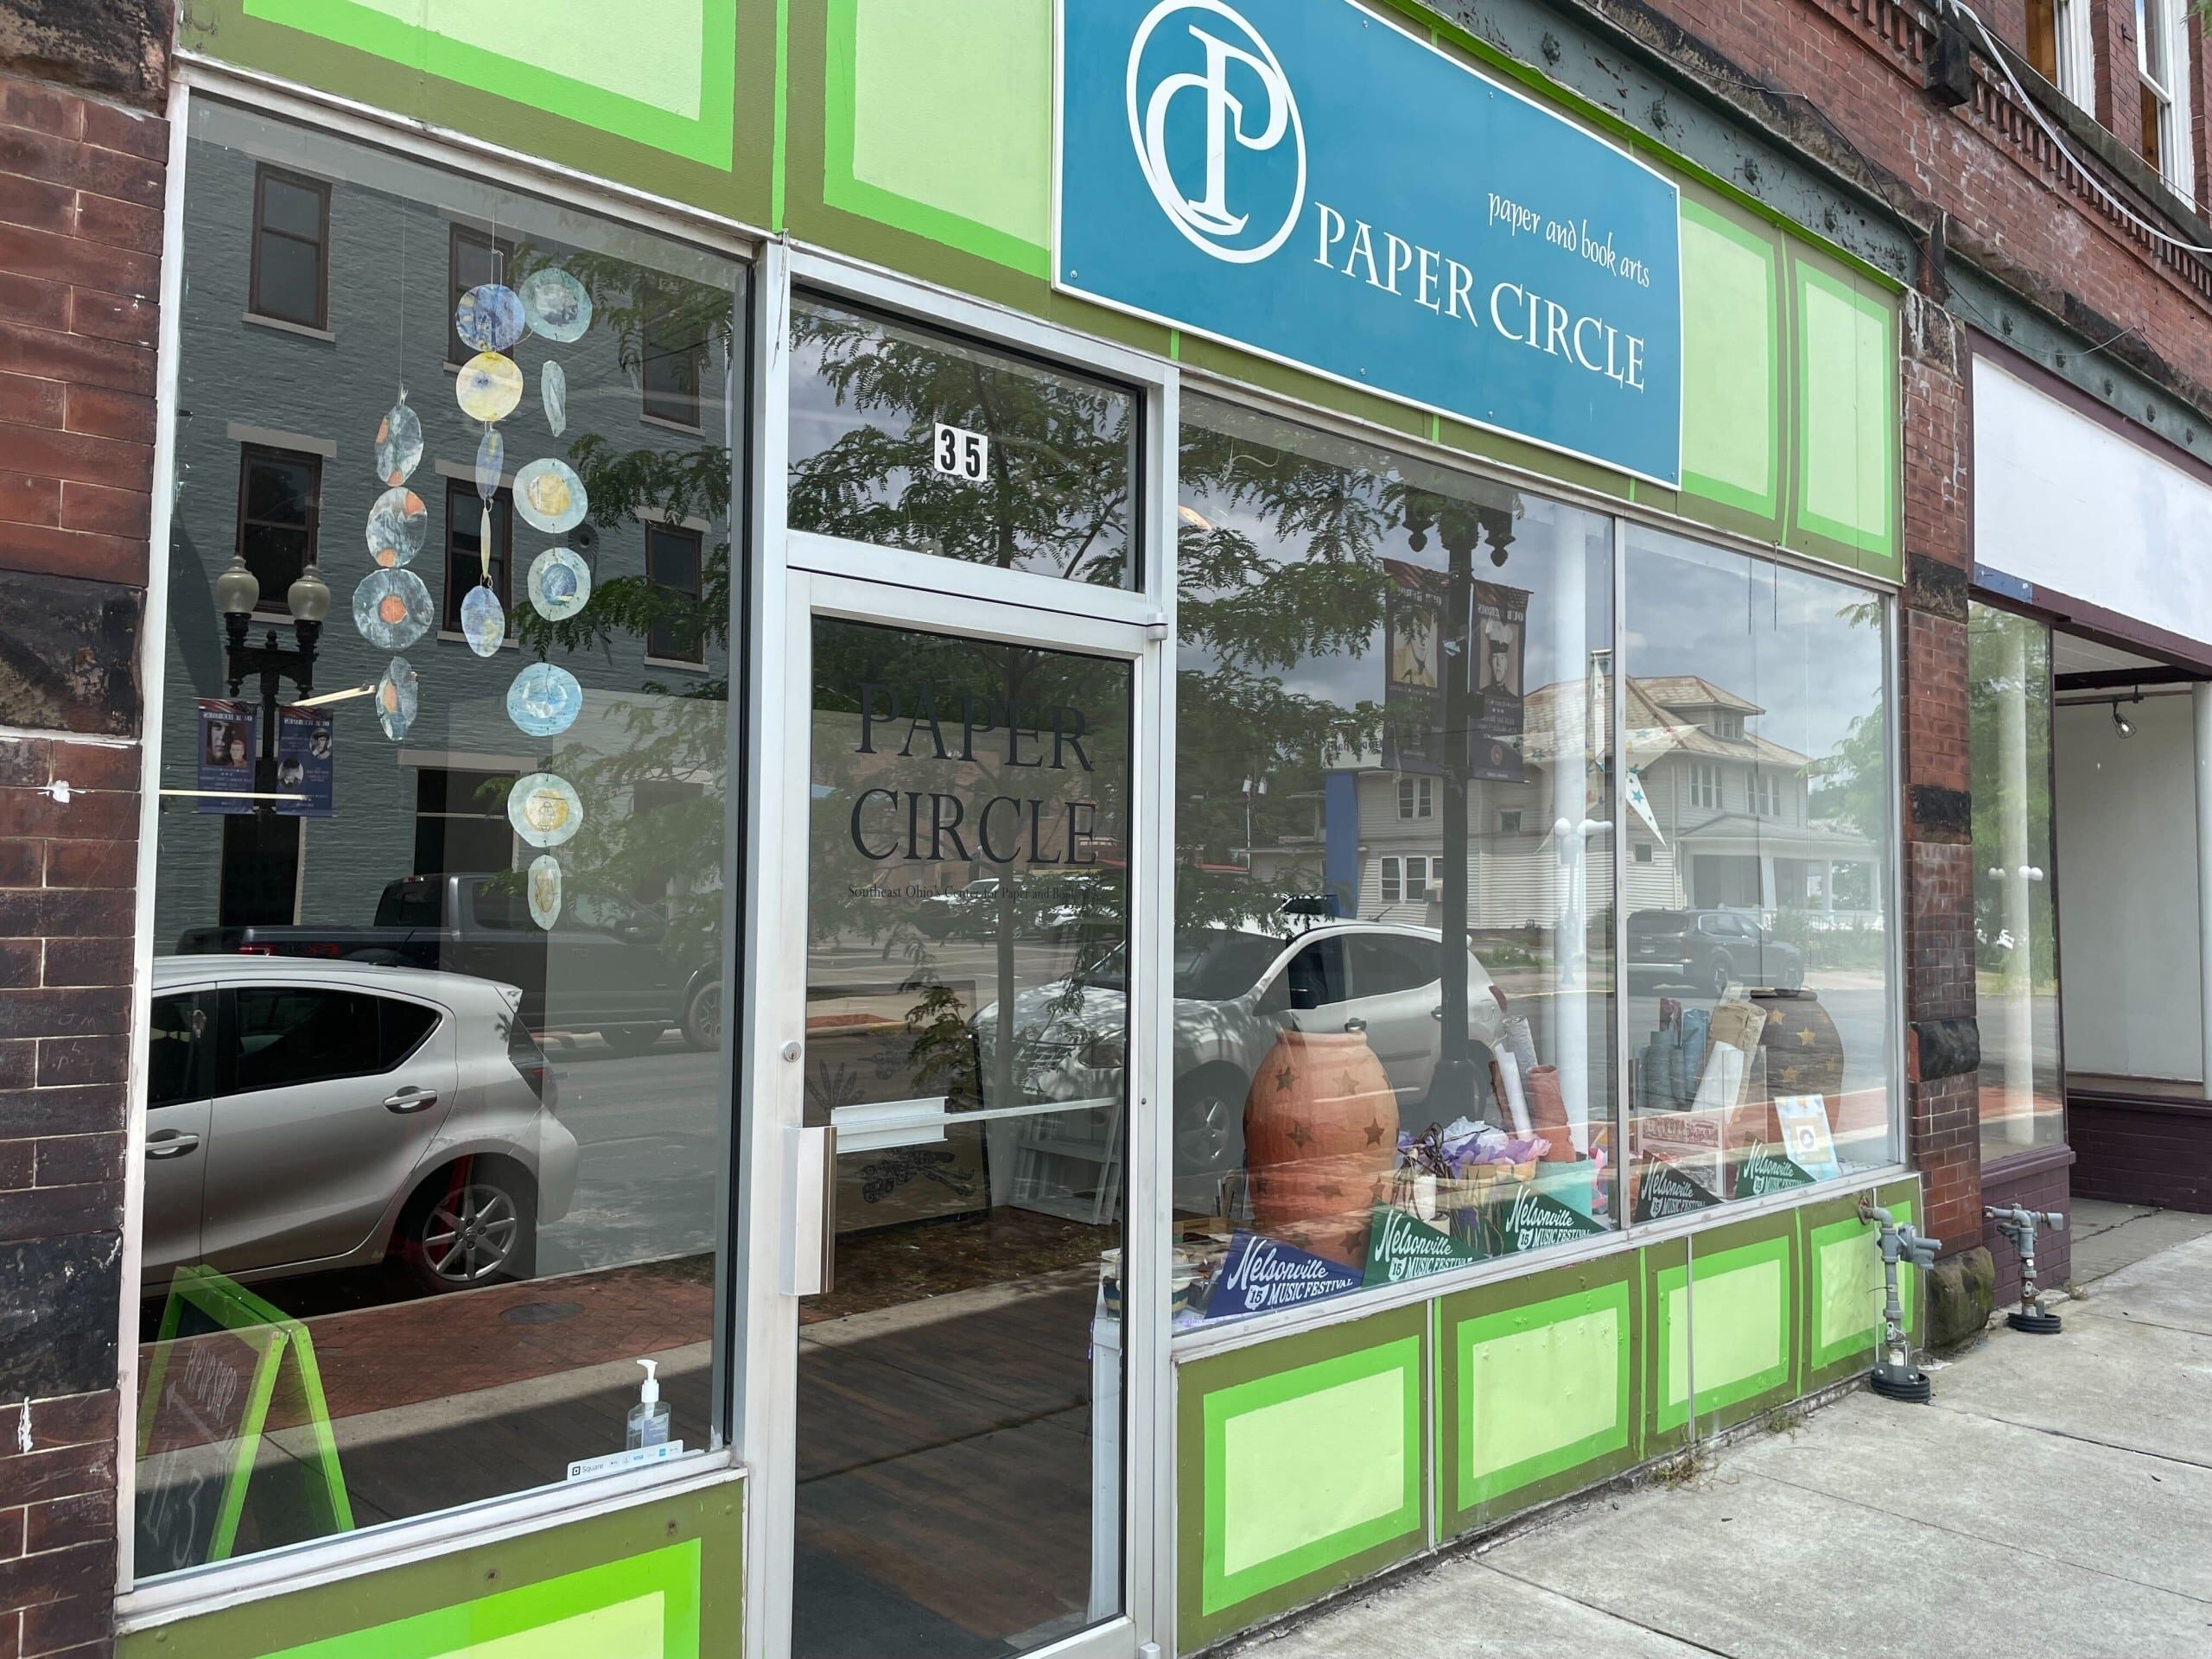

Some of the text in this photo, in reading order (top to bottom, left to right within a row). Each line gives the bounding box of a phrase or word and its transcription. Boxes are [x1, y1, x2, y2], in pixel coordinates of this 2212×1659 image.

[1487, 192, 1650, 289] paper and book arts
[1313, 200, 1645, 395] PAPER CIRCLE
[940, 428, 981, 479] 35
[855, 682, 1096, 772] PAPER
[850, 787, 1098, 865] CIRCLE
[849, 884, 901, 898] Southeast
[906, 884, 940, 898] Ohio's
[944, 885, 981, 898] Center
[1002, 887, 1029, 904] Paper
[1033, 887, 1049, 899] and
[1641, 1156, 1694, 1201] Nelsonville
[1744, 1138, 1795, 1179] Nelsonville
[1755, 1179, 1762, 1190] 15
[1505, 1184, 1574, 1234] Nelsonville
[1375, 1209, 1453, 1262] Nelsonville
[1521, 1233, 1529, 1245] 15
[1532, 1228, 1558, 1248] MUSIC
[1227, 1236, 1328, 1291] Nelsonville
[1392, 1262, 1402, 1276] 15
[1405, 1256, 1434, 1279] MUSIC
[1250, 1278, 1353, 1306] 15 MUSIC FESTIVAL
[582, 1463, 604, 1473] Square
